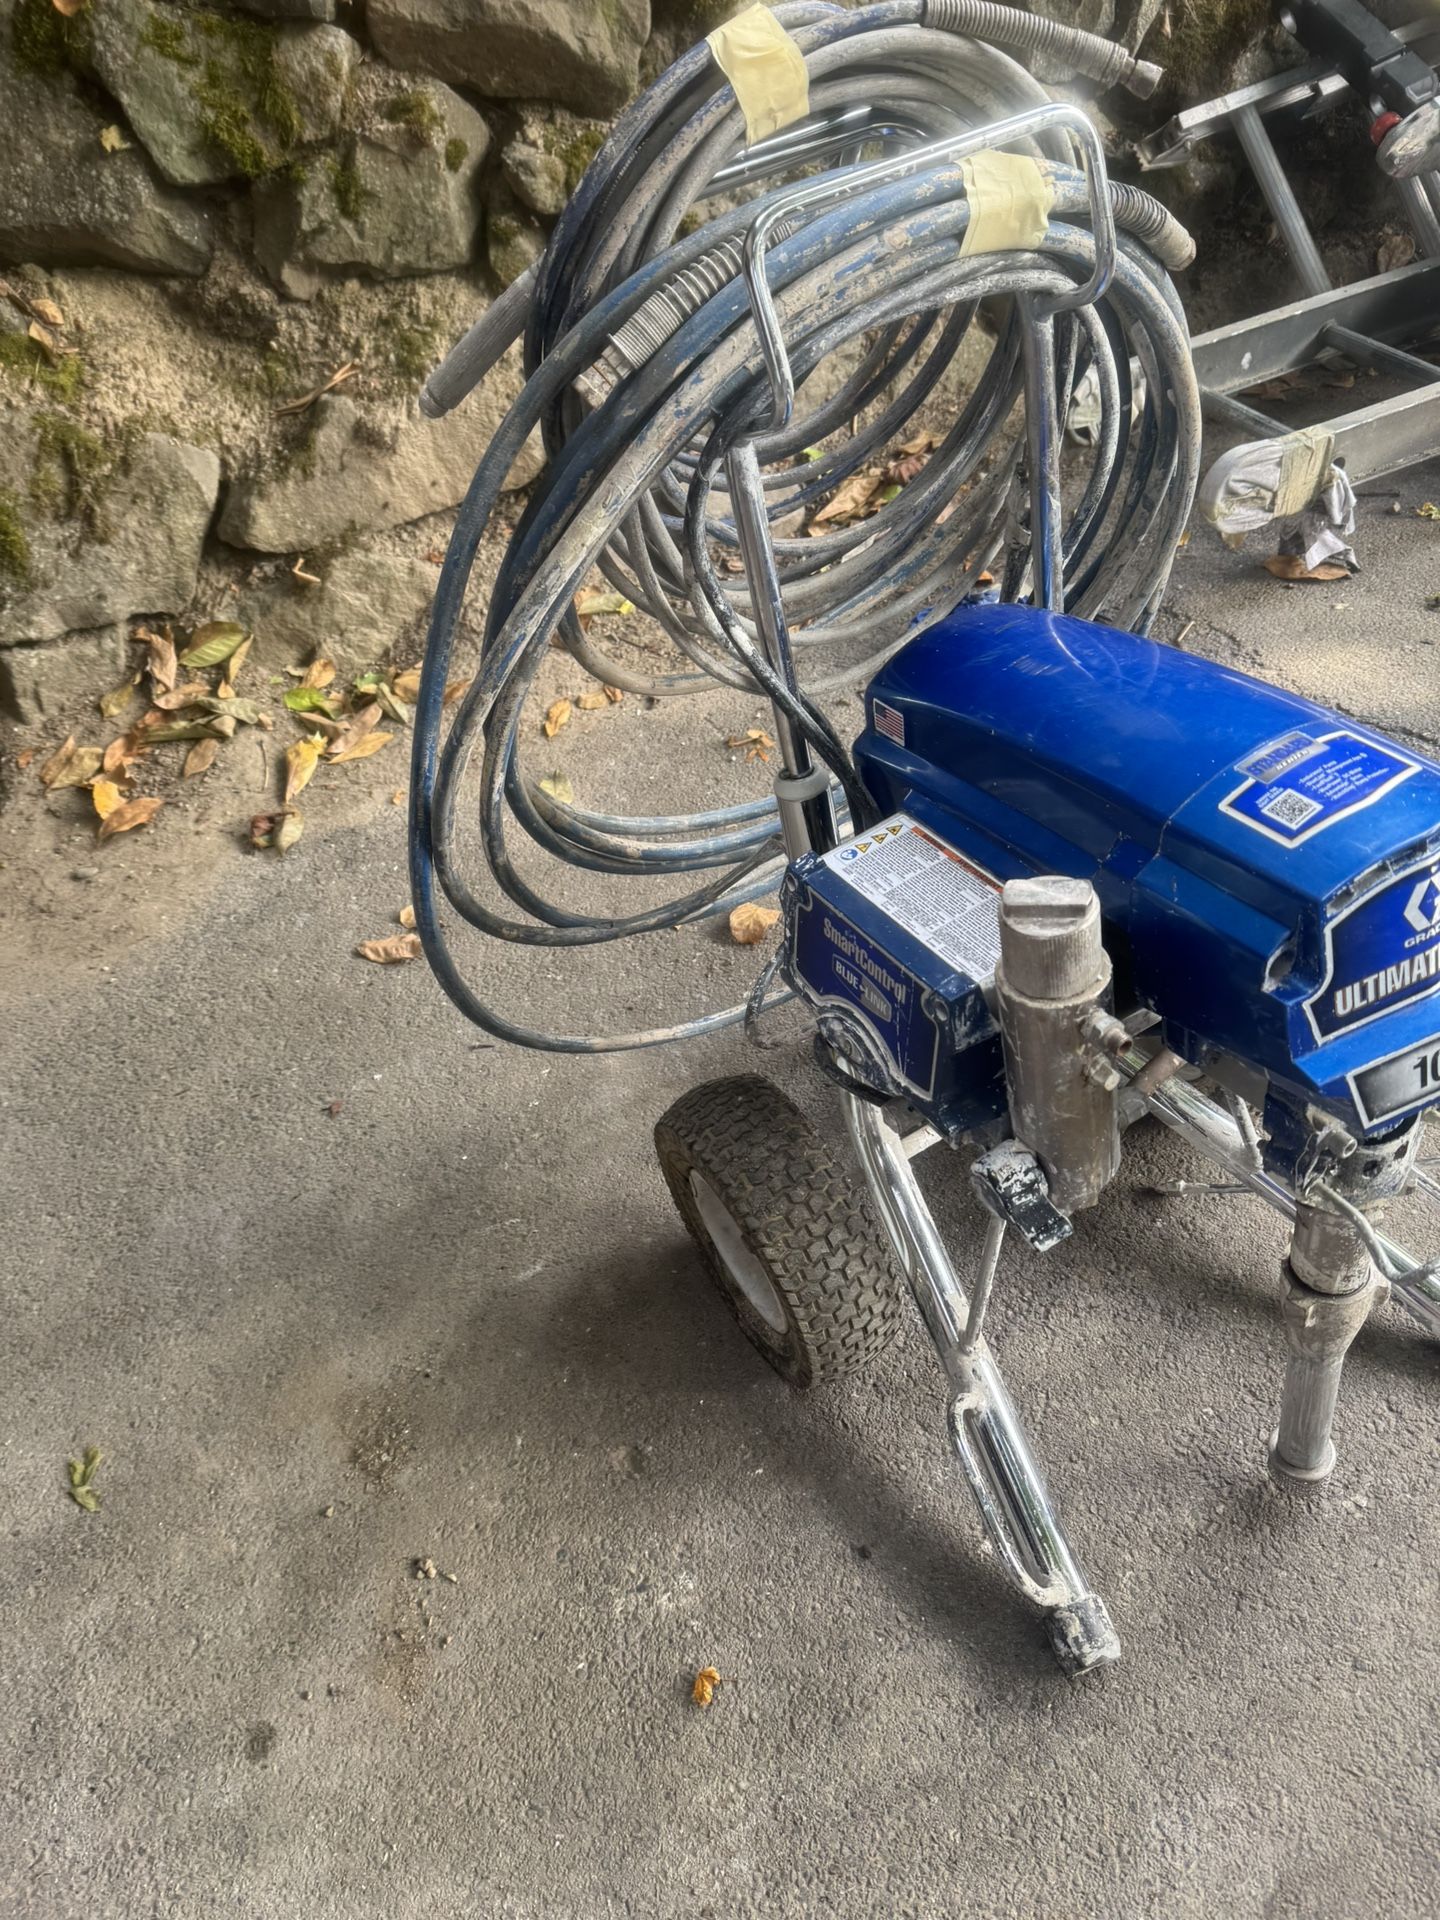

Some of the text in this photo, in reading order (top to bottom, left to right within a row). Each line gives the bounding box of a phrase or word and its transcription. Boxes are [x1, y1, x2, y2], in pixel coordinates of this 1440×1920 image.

[823, 917, 906, 1004] SmartControl
[835, 960, 888, 1015] BLUE LINK
[1334, 942, 1440, 1016] ULTIMAT
